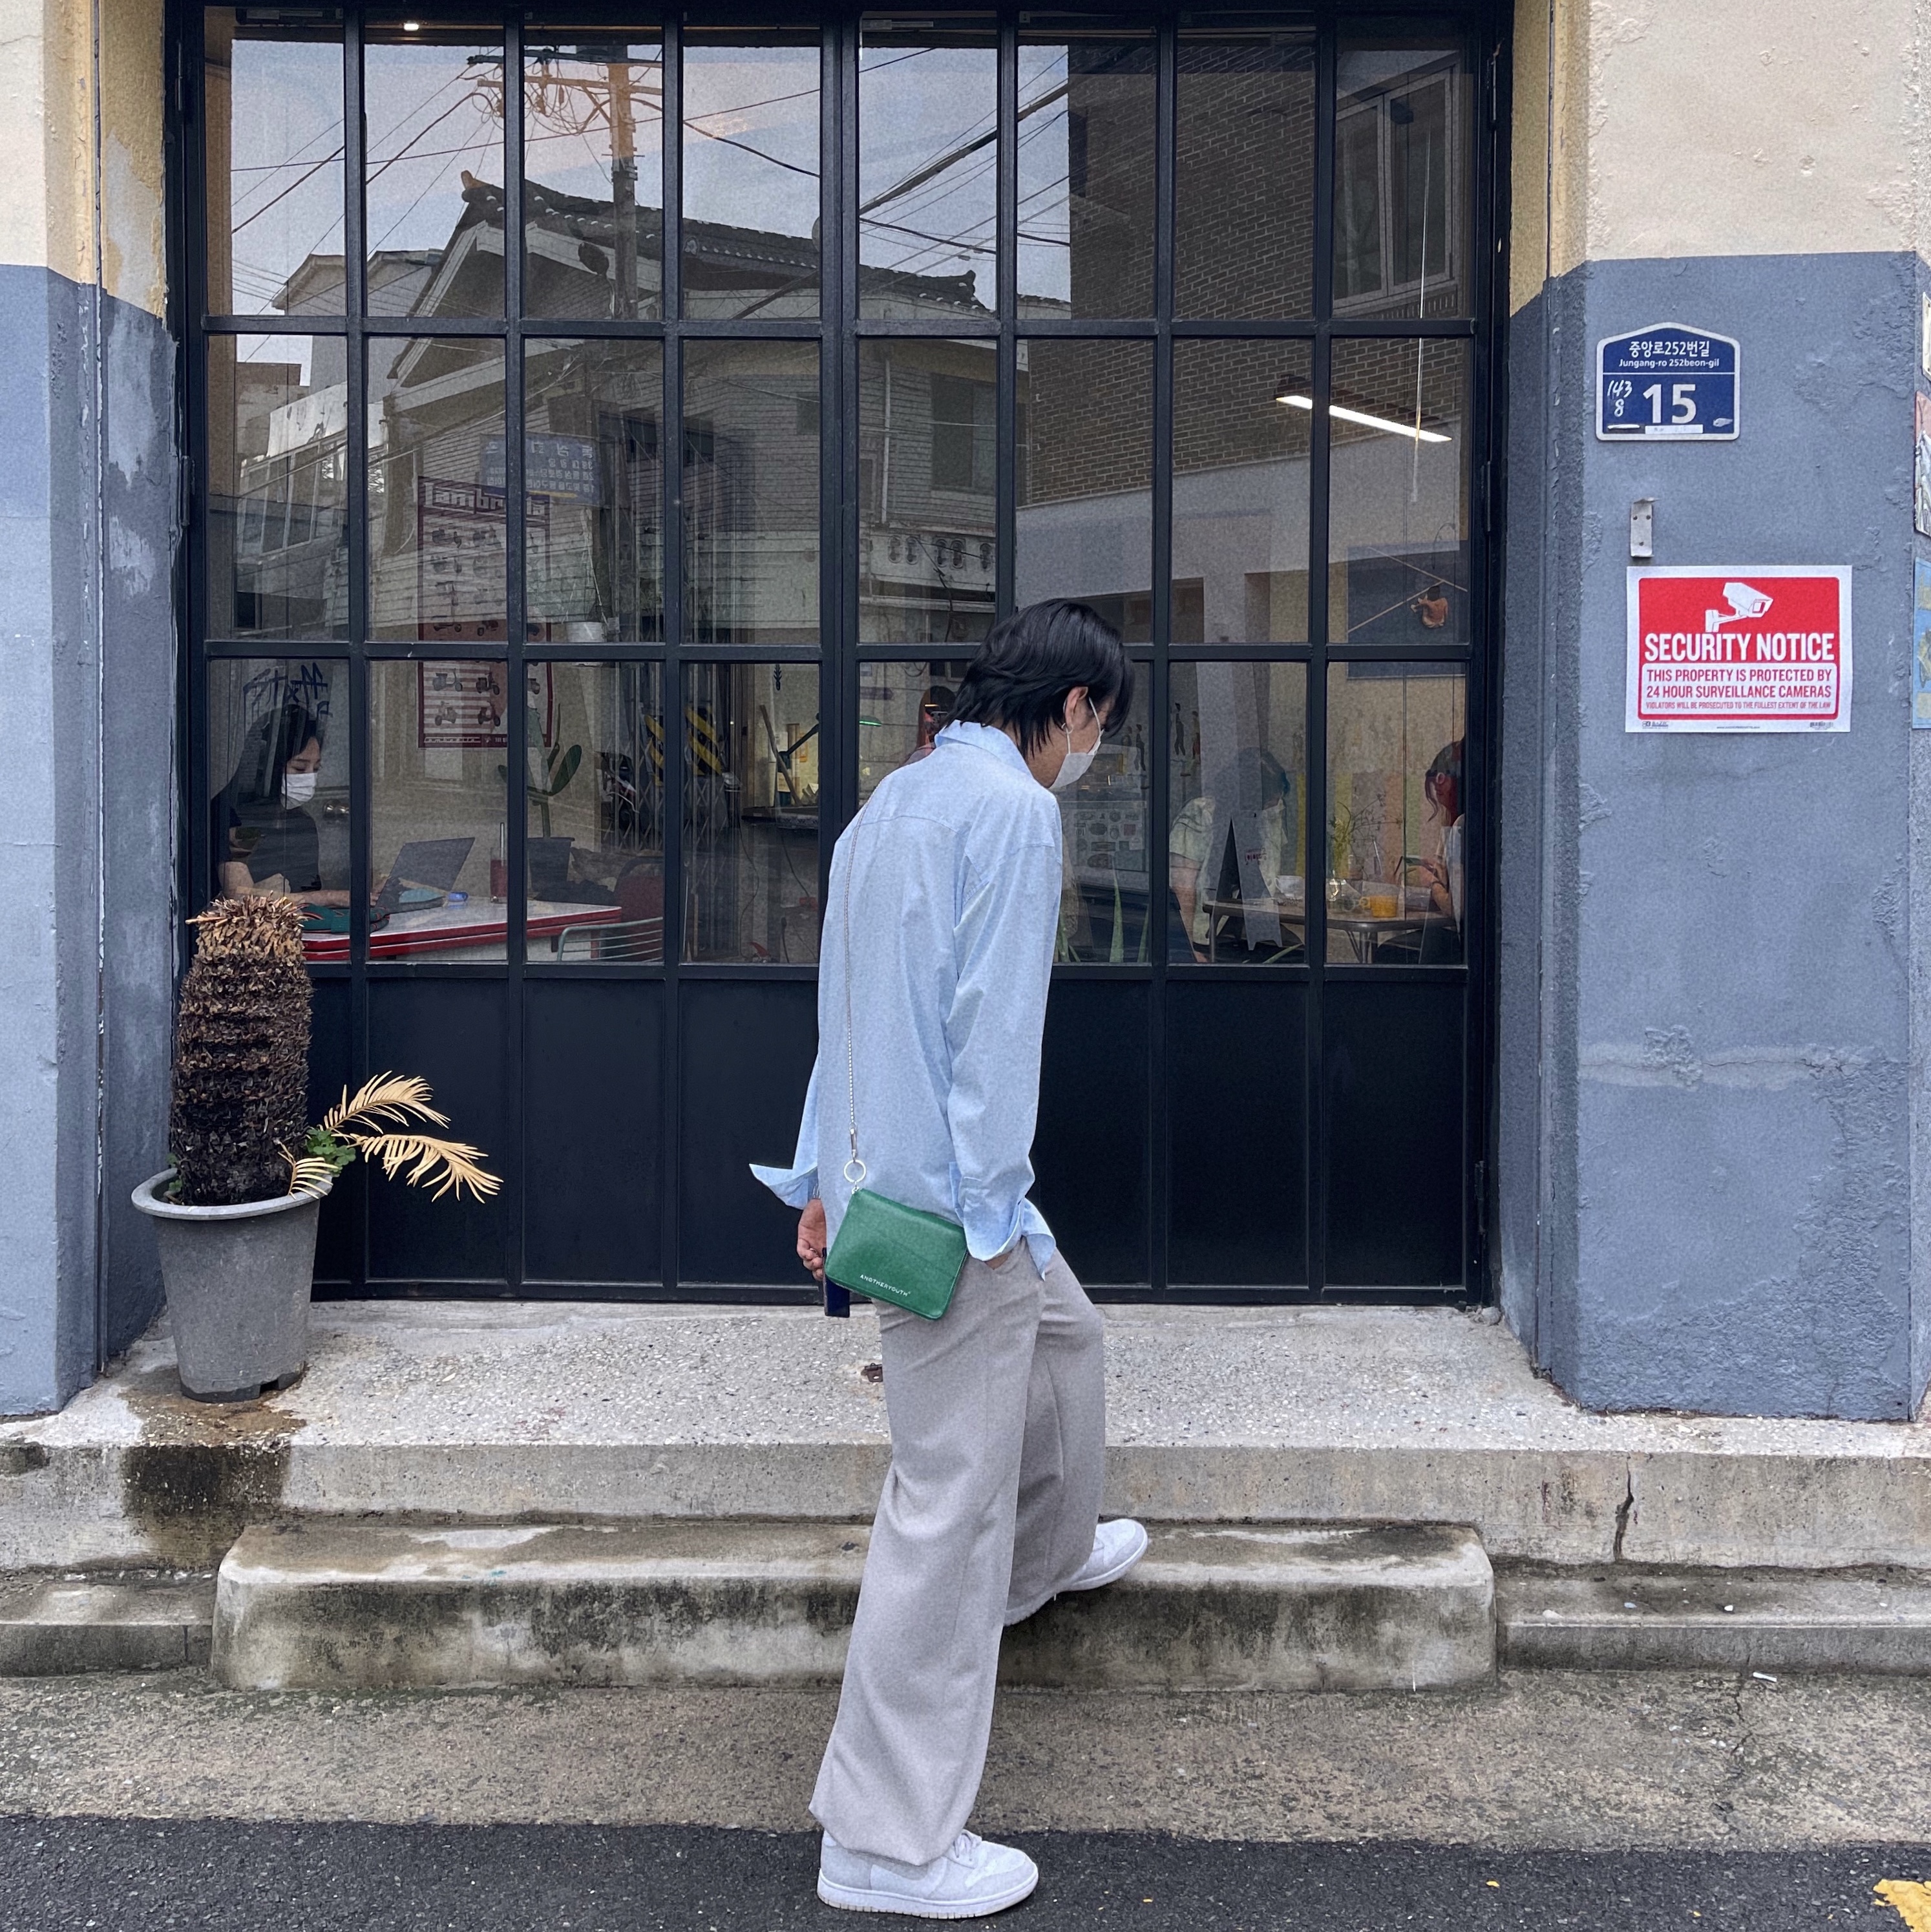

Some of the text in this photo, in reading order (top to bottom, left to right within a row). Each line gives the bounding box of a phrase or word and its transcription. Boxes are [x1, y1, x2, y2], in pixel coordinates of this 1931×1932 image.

[1629, 340, 1710, 358] 중앙로252번길
[1618, 358, 1720, 369] Jungang-ro 252beon-gil
[1643, 384, 1697, 424] 15
[1644, 632, 1835, 661] SECURITY NOTICE
[1647, 669, 1831, 681] THIS PROPERTY IS PROTECTED BY
[1647, 685, 1831, 698] 24 HOUR SURVEILLANCE CAMERAS
